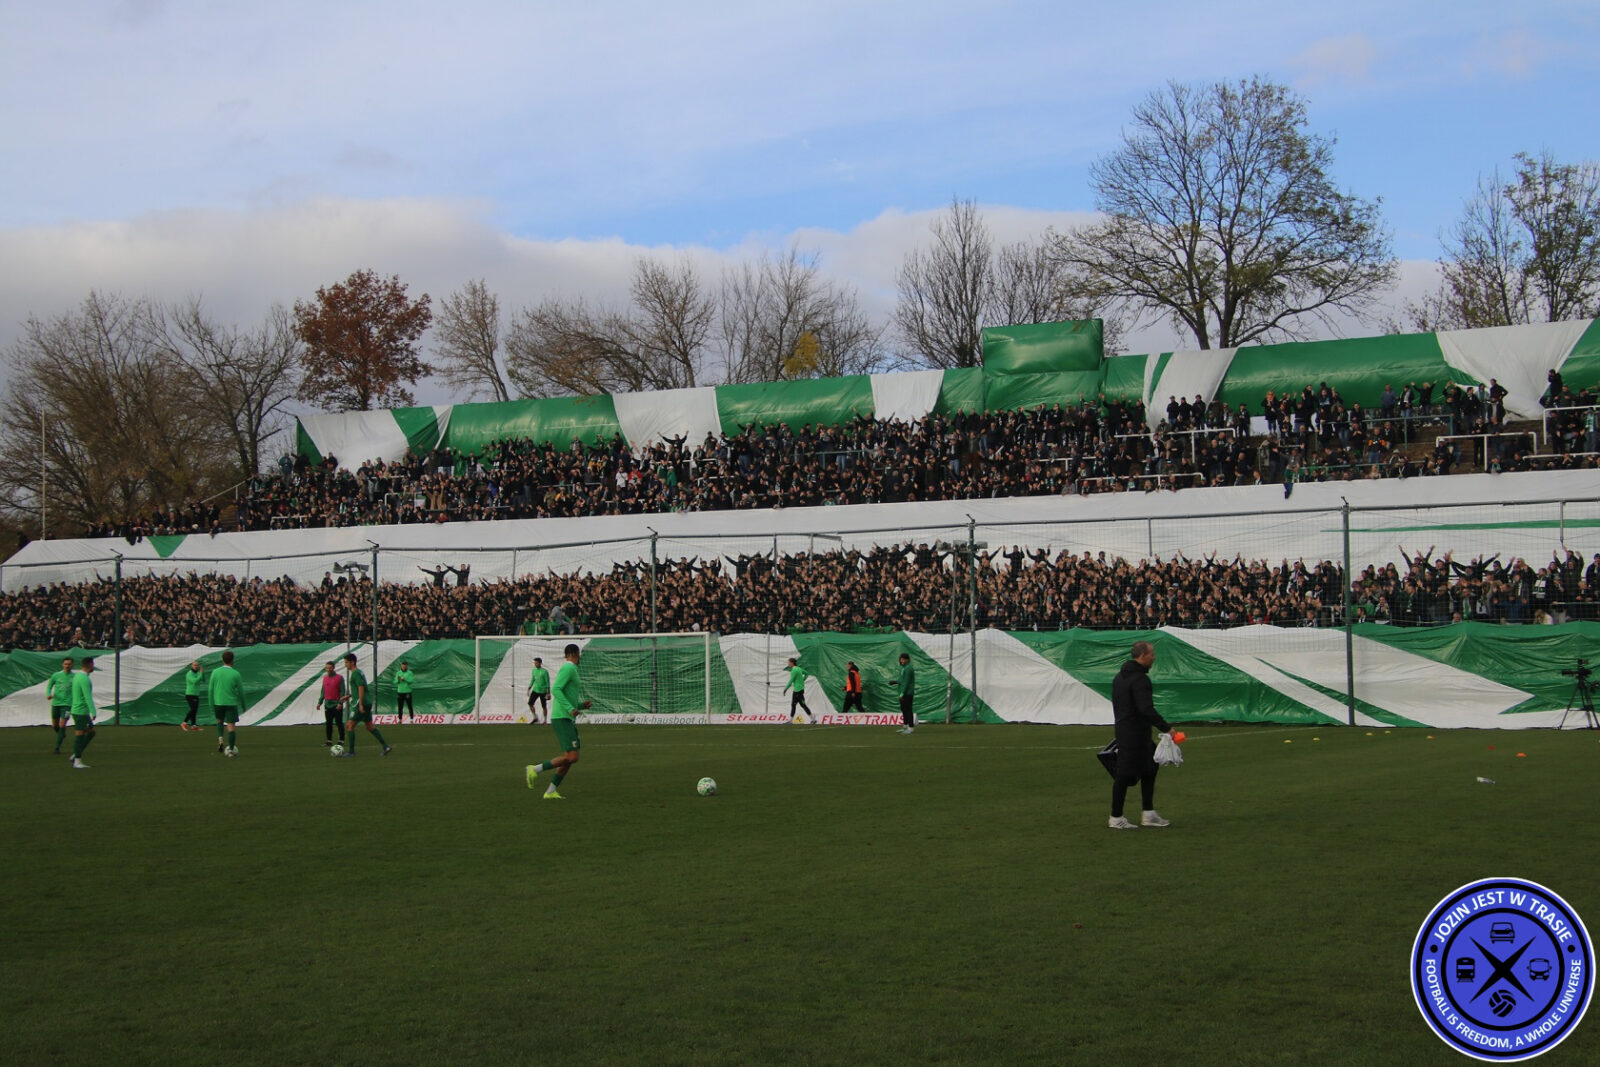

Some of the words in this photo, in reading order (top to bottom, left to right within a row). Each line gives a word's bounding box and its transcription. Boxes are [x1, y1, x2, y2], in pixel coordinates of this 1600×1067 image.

[373, 715, 399, 725] FLEX
[411, 714, 446, 724] RANS
[821, 714, 852, 725] FLEX
